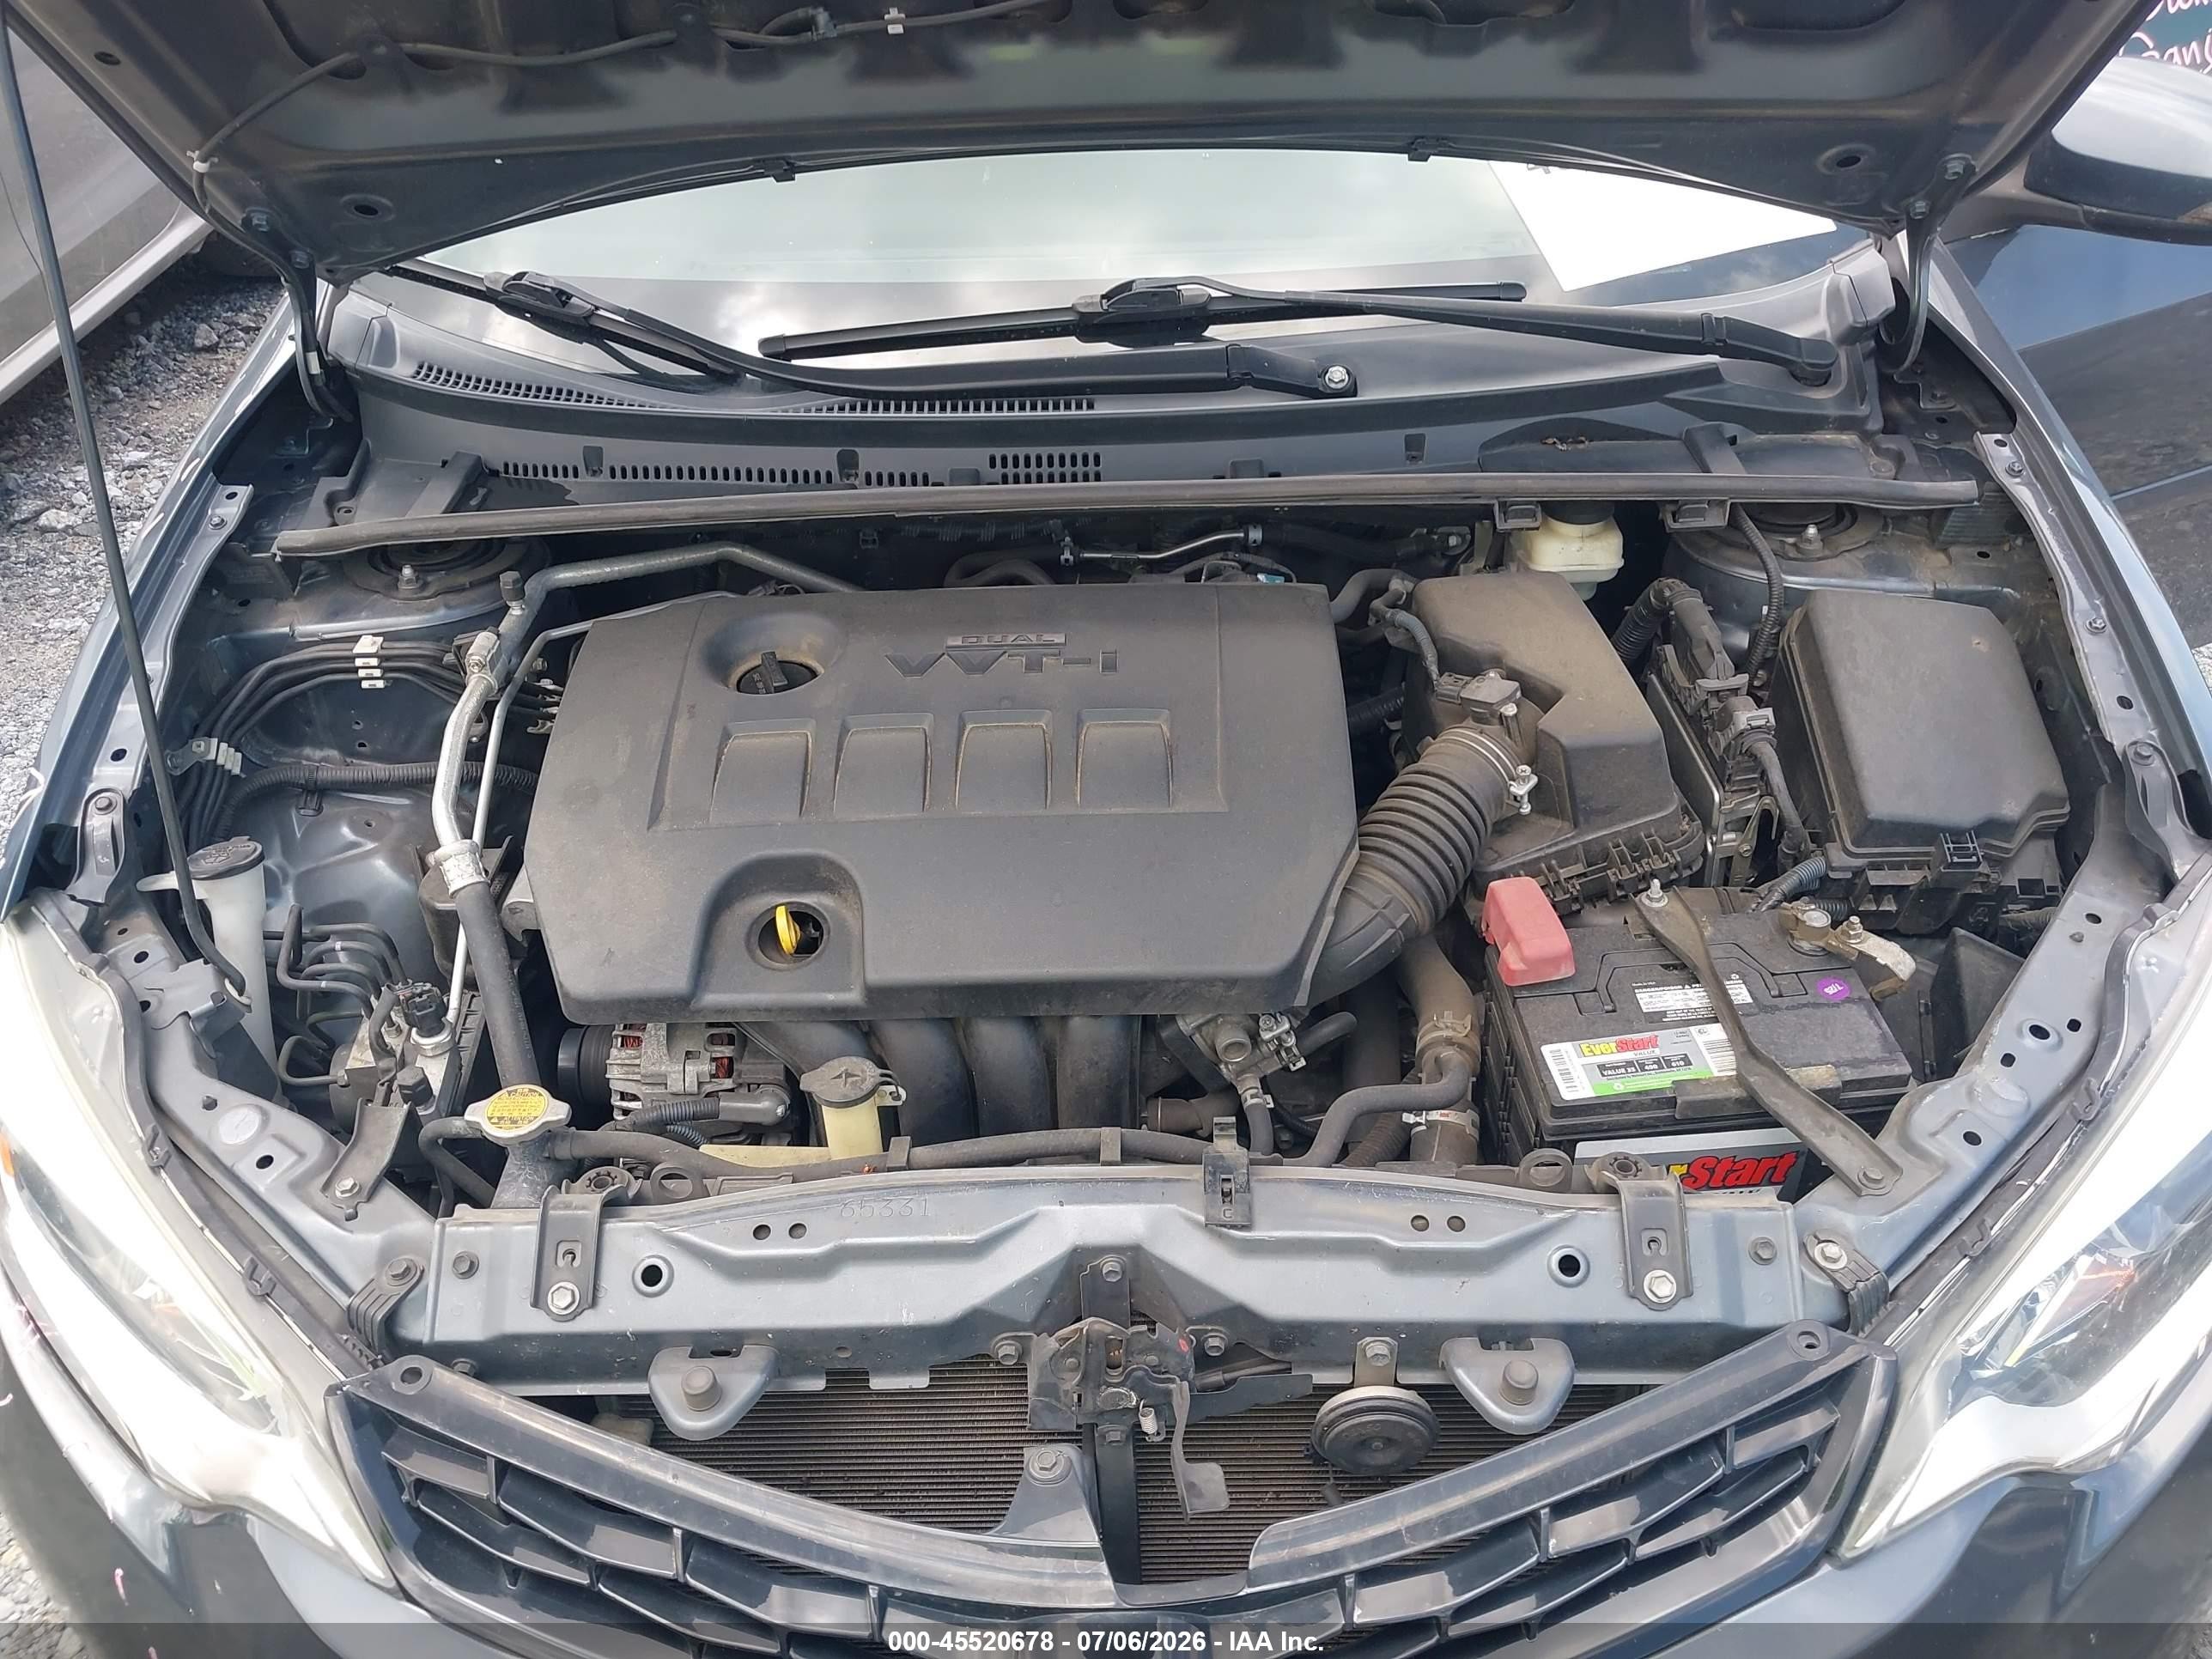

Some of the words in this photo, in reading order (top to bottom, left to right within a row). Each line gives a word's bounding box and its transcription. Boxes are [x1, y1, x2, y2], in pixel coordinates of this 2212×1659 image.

[961, 634, 1055, 644] DUAL
[1580, 1035, 1659, 1057] EverStart
[1602, 1067, 1626, 1076] VALUE
[1668, 1150, 1801, 1190] rStart
